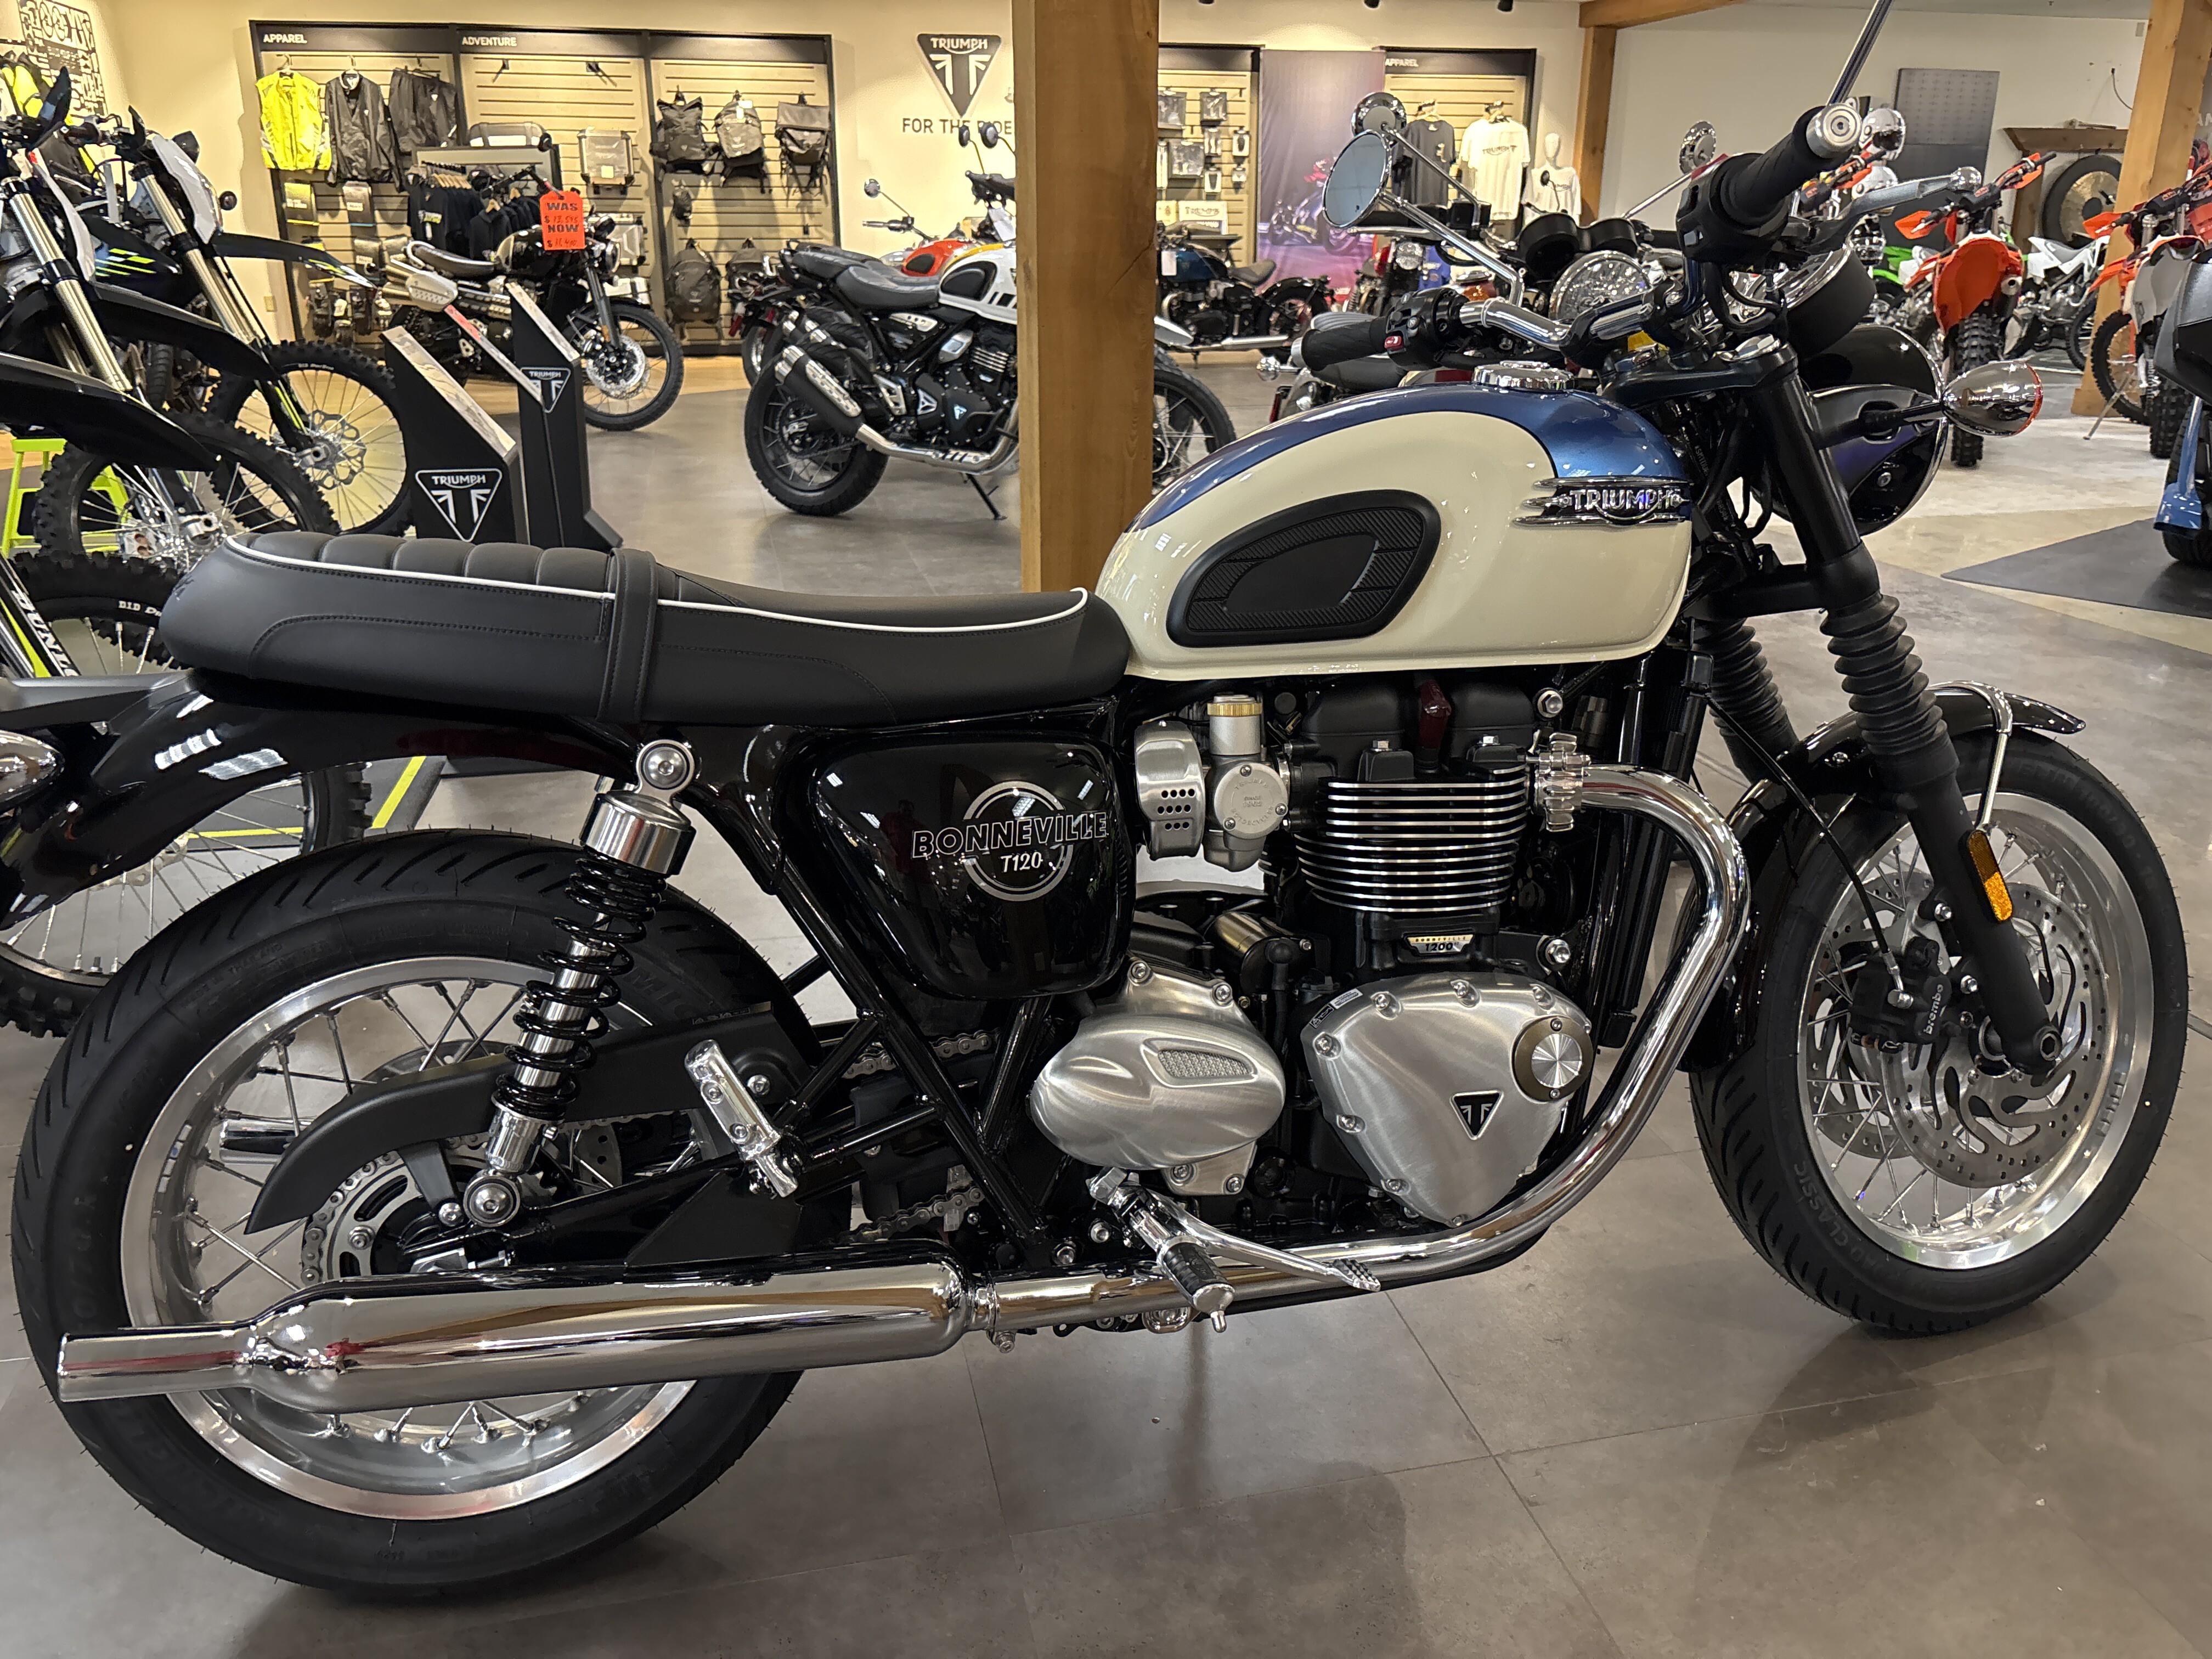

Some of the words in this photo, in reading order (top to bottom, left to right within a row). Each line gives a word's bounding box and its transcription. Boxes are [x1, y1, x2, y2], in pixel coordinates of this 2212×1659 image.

[263, 33, 308, 44] APPAREL
[462, 36, 517, 47] ADVENTURE
[930, 37, 988, 54] TRIUMPH
[1385, 58, 1419, 67] APPAREL
[902, 117, 934, 133] FOR
[546, 202, 578, 211] WAS
[548, 223, 579, 233] NOW
[529, 371, 562, 381] TRIUMPH
[431, 474, 487, 489] TRIUMPH
[1569, 489, 1672, 520] TRIUMPH
[912, 811, 1107, 859] BONNEVILLE
[1000, 851, 1042, 873] T120
[1425, 942, 1453, 952] 1200
[1923, 984, 1944, 1035] brembo
[1793, 1160, 1849, 1246] CLASSIC
